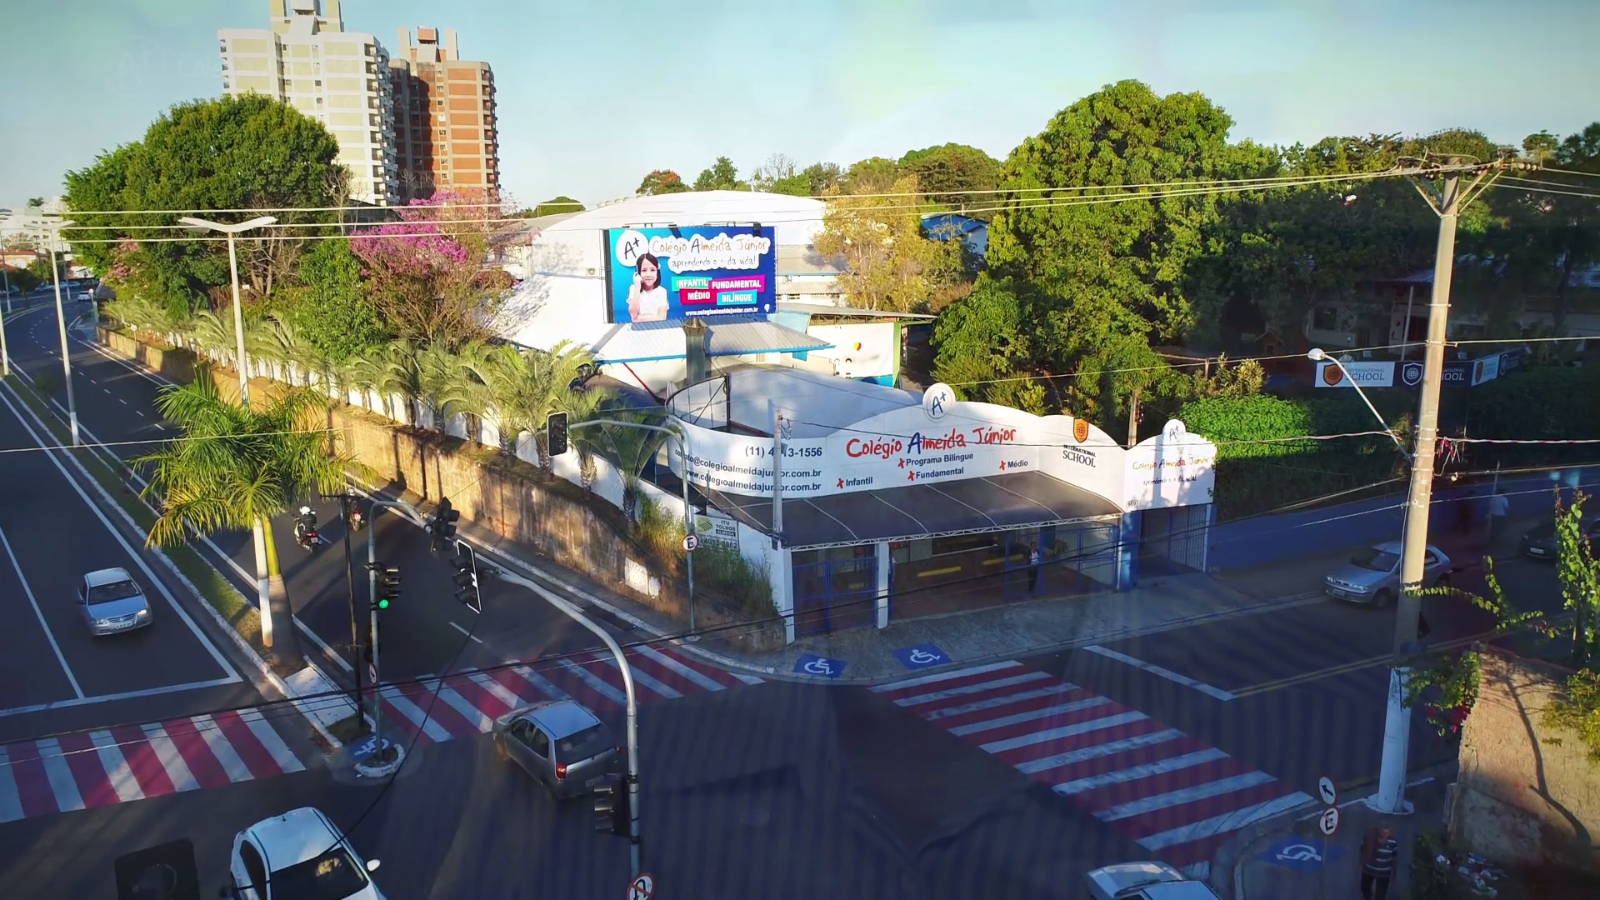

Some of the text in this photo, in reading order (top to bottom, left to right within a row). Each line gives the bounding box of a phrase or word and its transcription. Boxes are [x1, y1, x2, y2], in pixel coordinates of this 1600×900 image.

[624, 237, 640, 260] A+
[652, 238, 767, 256] Colégio Almeida Júnior
[672, 257, 710, 269] aprendendo
[727, 256, 737, 265] da
[677, 279, 709, 289] INFANTIL
[712, 280, 762, 289] FUNDAMENTAL
[687, 291, 711, 301] MÉDIO
[721, 292, 753, 303] BILÍNGUE
[932, 391, 947, 416] A+
[846, 426, 1016, 459] Colégio Almeida Júnior
[745, 446, 823, 458] (11) 413-1556
[906, 458, 942, 467] Programa
[1007, 460, 1029, 469] Médio
[1062, 450, 1096, 468] SCHOOL
[916, 467, 964, 479] Fundamental
[846, 477, 873, 487] Infantil
[687, 537, 694, 549] E
